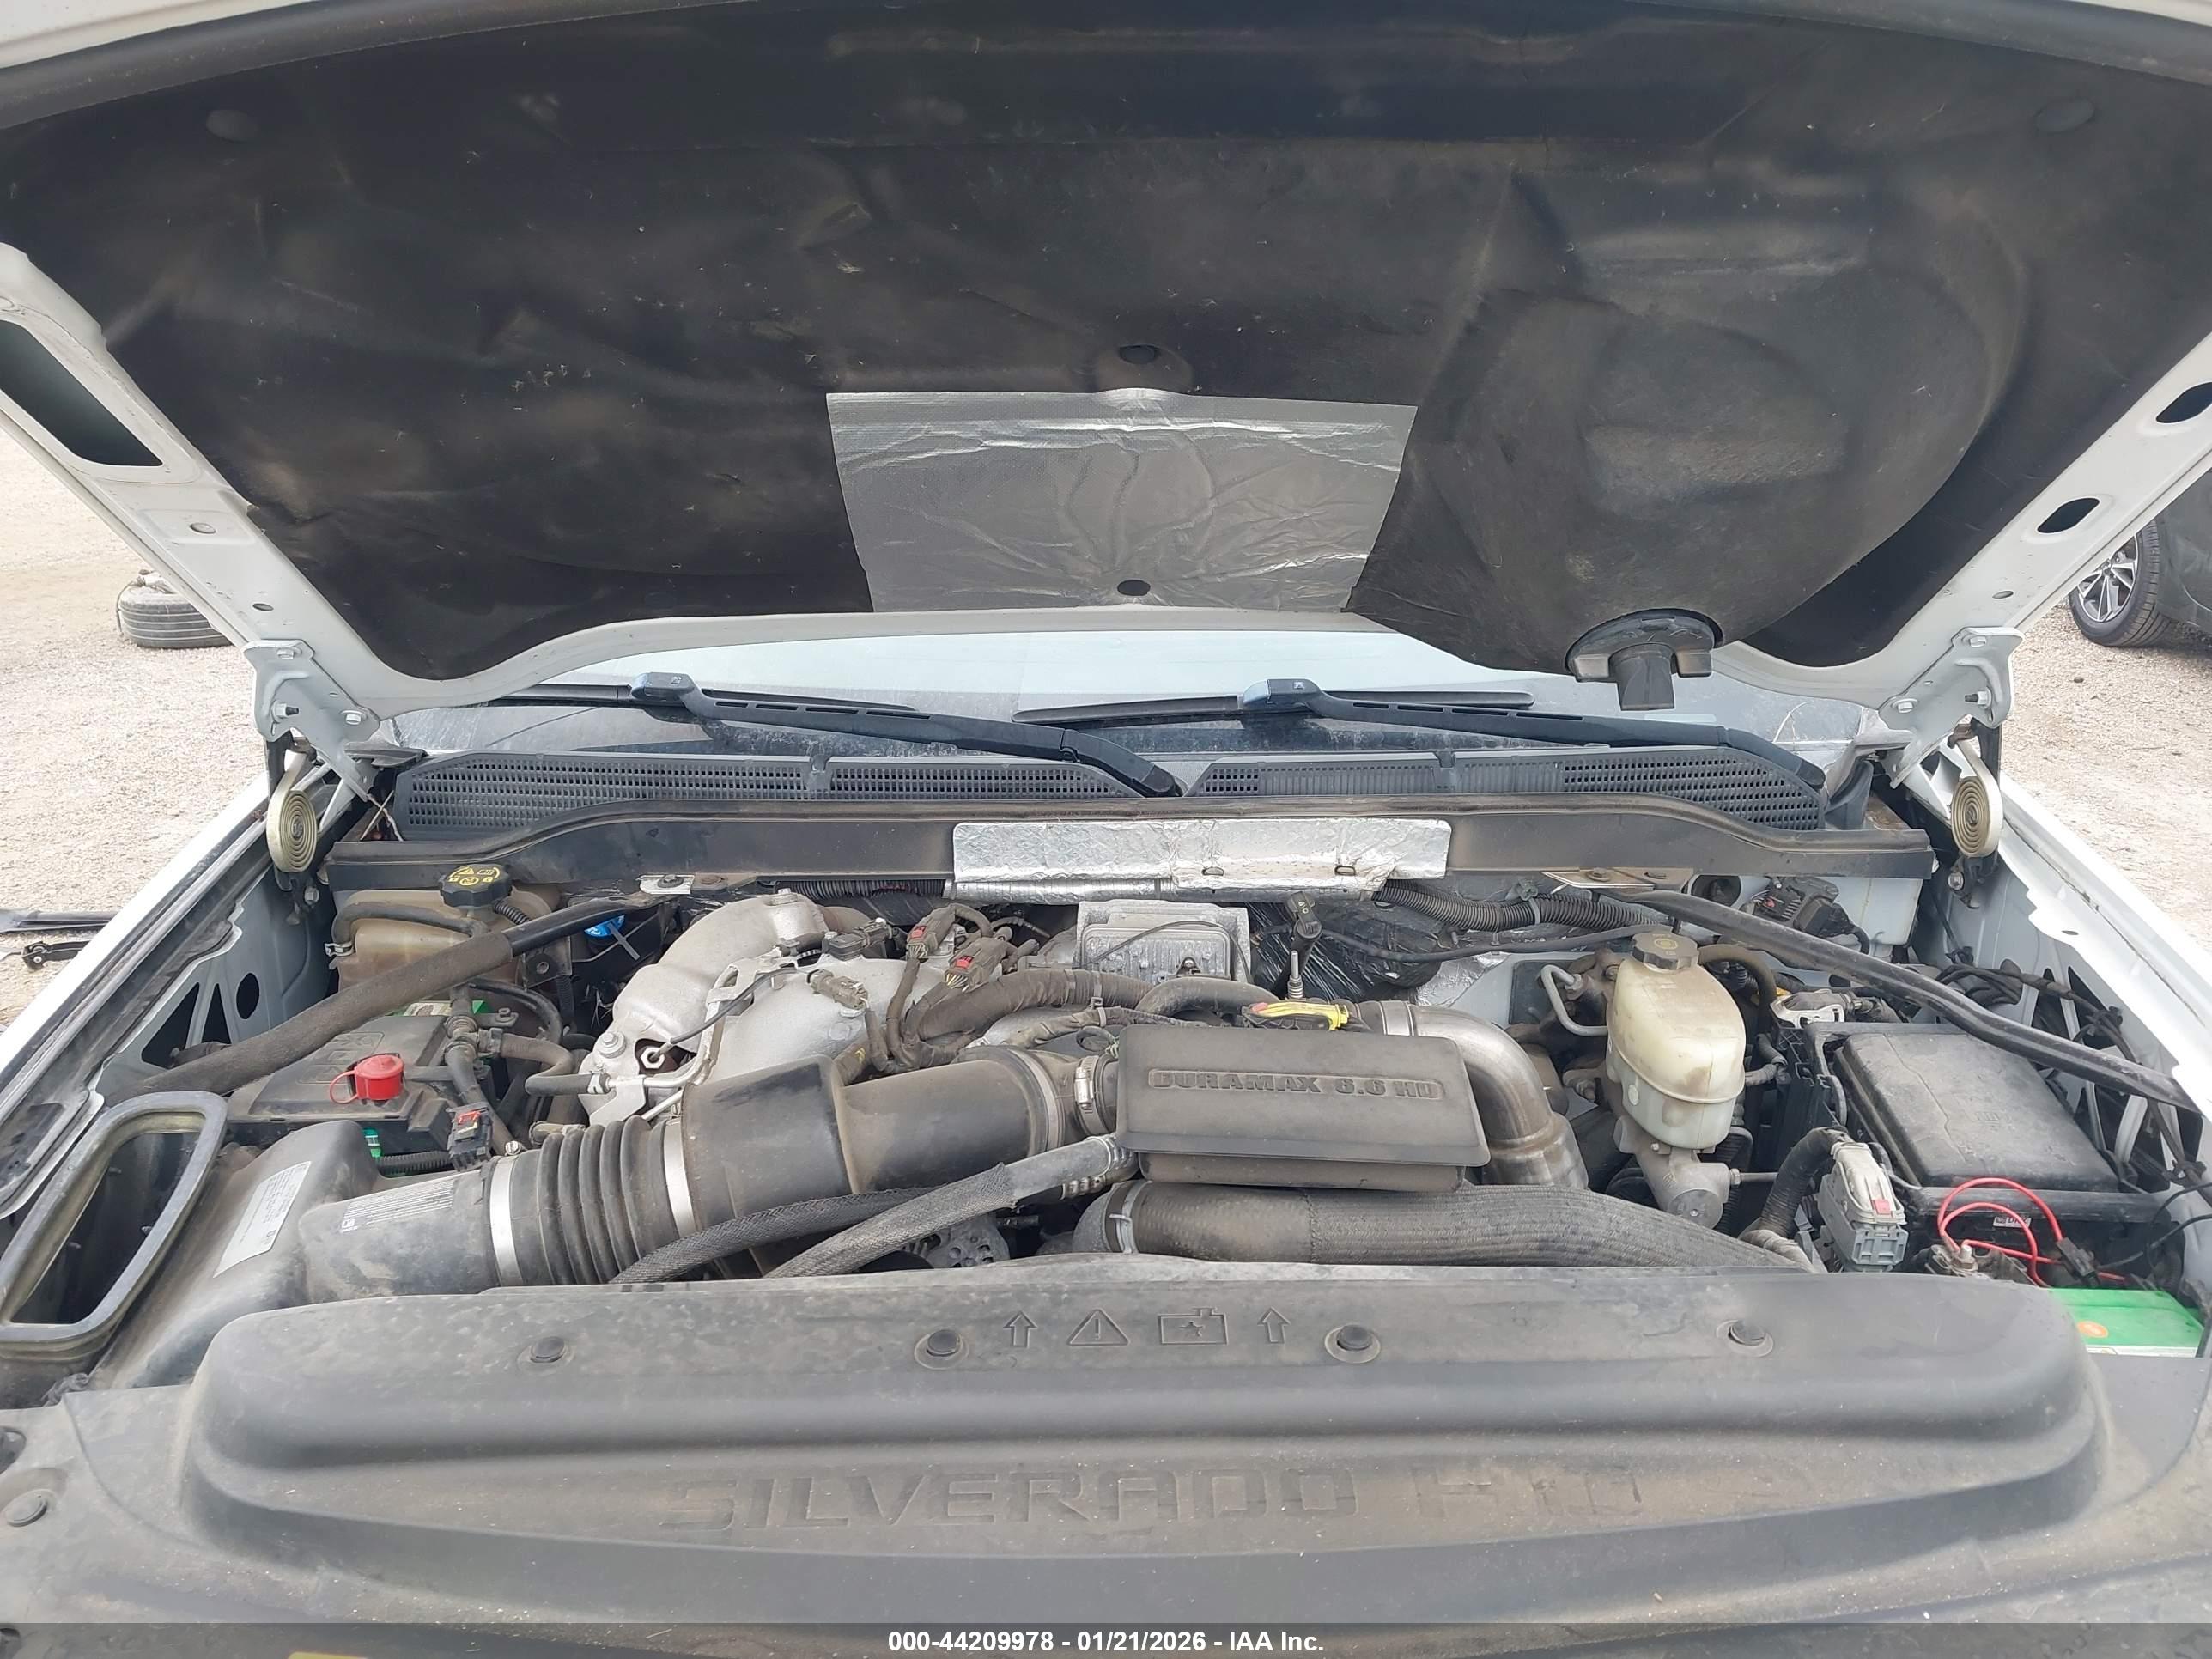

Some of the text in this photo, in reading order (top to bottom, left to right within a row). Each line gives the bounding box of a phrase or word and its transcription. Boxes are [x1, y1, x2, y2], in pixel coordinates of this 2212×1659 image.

[1152, 1070, 1442, 1099] DURAMAX 6.6 HD
[659, 1465, 1642, 1532] SILVERADO HD
